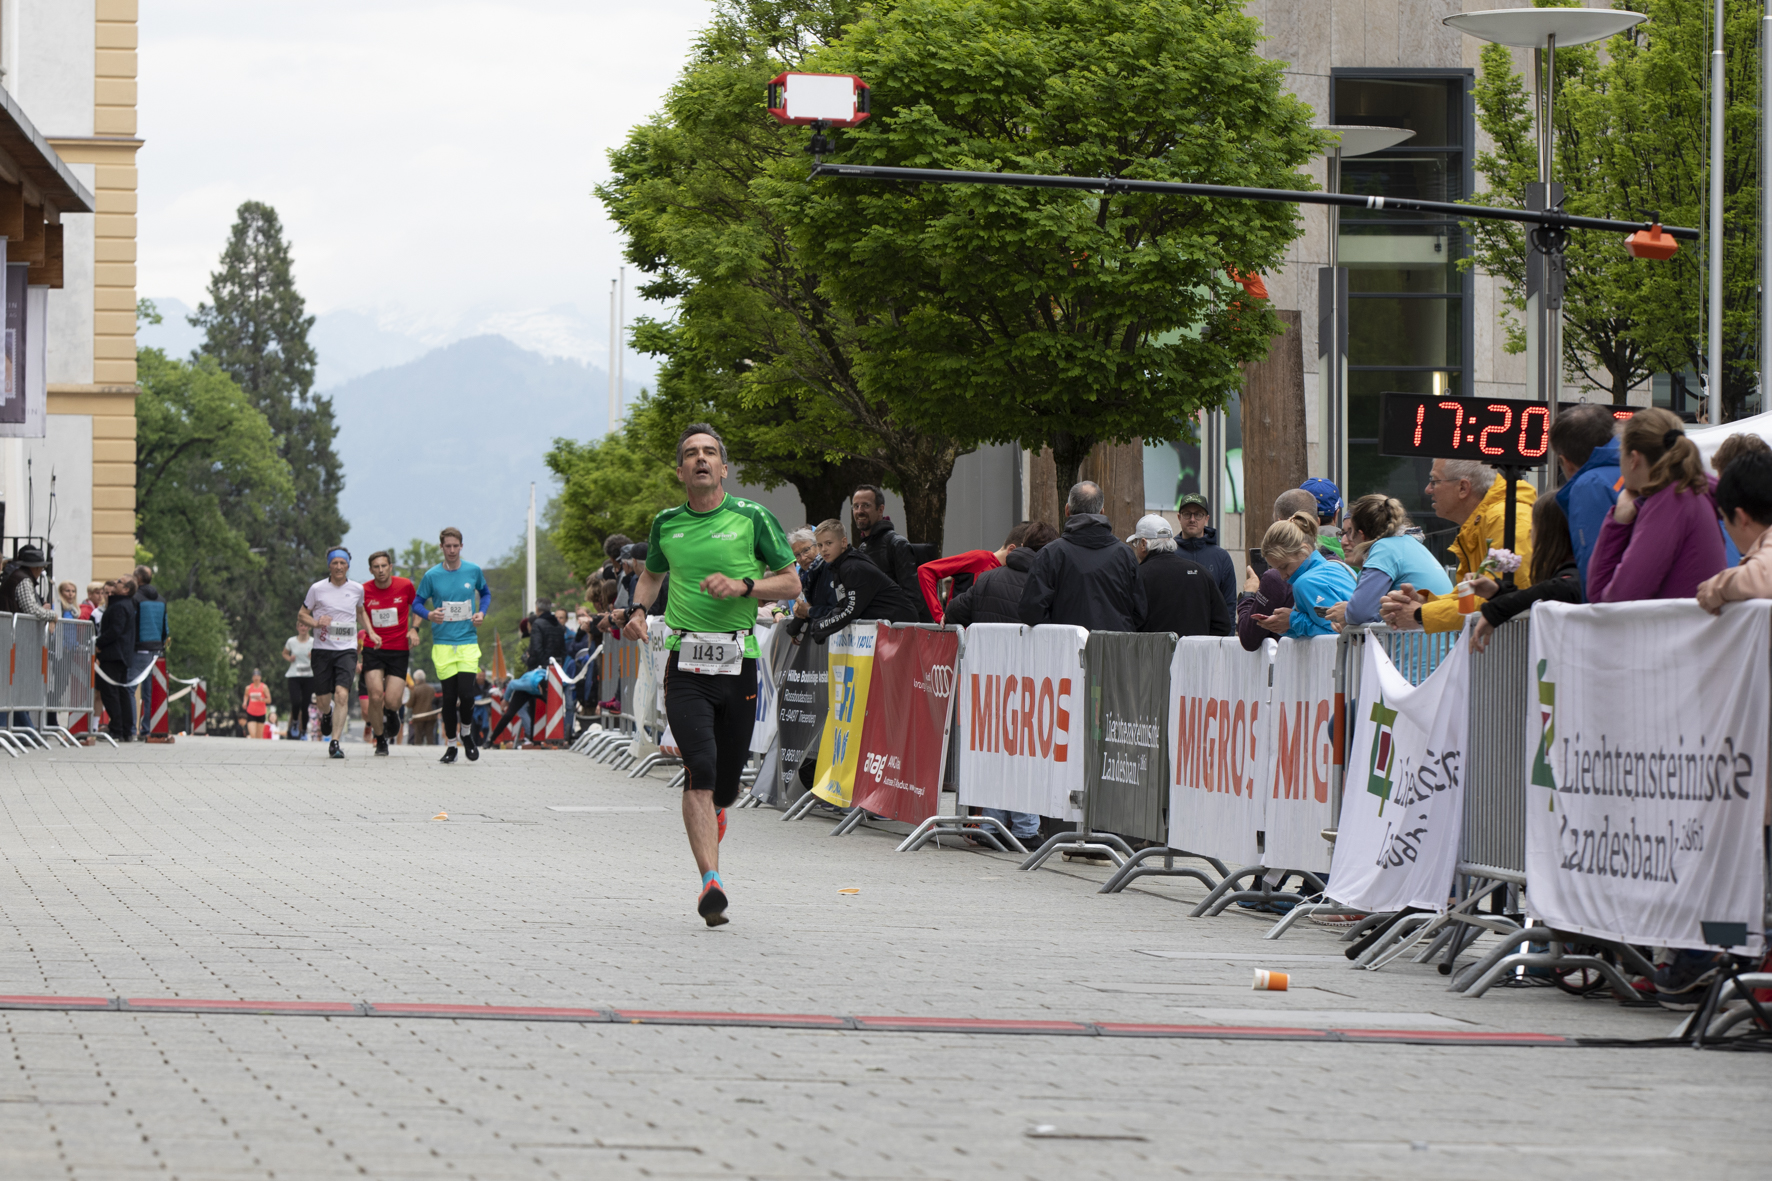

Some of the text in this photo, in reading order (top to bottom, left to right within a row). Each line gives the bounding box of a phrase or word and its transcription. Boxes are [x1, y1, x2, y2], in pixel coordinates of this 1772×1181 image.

[1413, 402, 1550, 457] 17:20
[335, 627, 351, 636] 1054
[379, 612, 390, 620] 820
[692, 644, 725, 662] 1143
[969, 673, 1072, 763] MIGROS
[1175, 695, 1259, 800] MIGROS
[1559, 732, 1753, 802] Liechtensteinische
